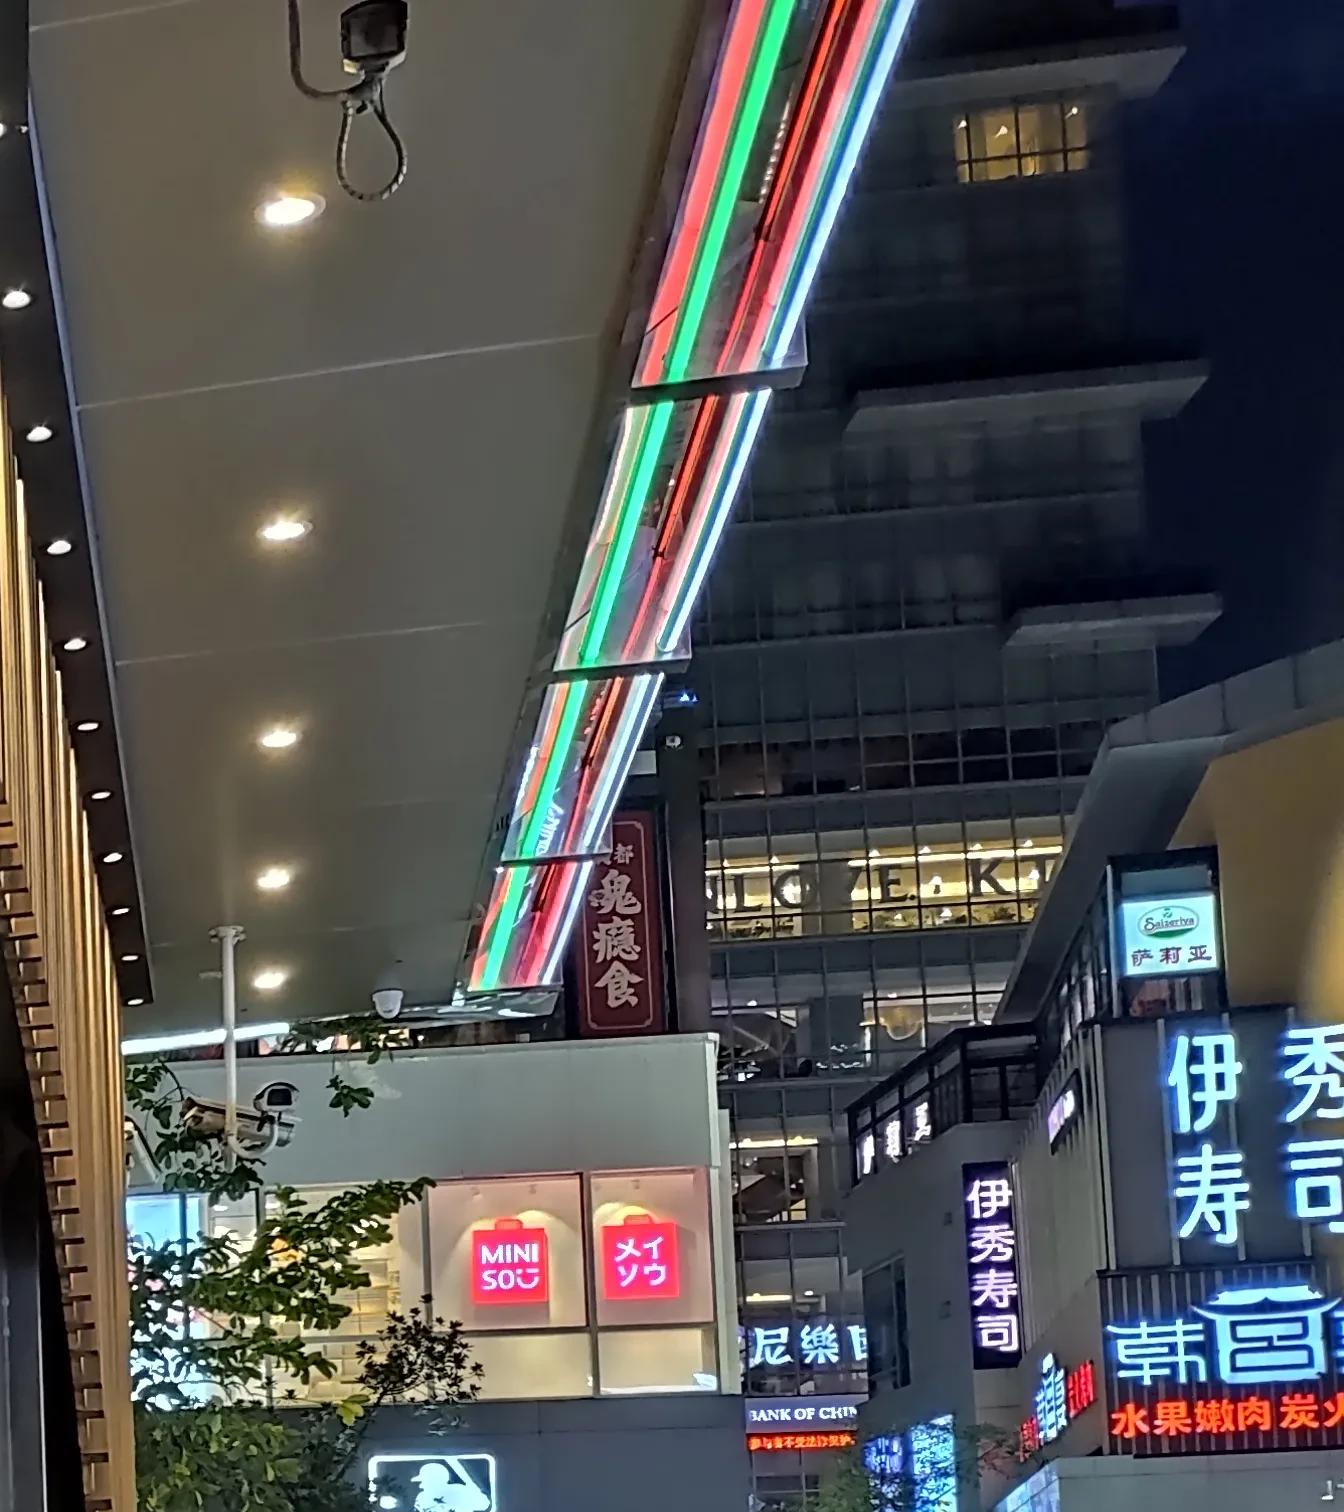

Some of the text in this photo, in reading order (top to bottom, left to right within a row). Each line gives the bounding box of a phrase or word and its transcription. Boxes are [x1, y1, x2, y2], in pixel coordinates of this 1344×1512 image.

[1132, 945, 1212, 967] 萨莉亚
[480, 1240, 540, 1263] MINI
[614, 1237, 663, 1263] メイ
[616, 1263, 667, 1288] ソウ
[967, 1178, 1019, 1352] 伊秀寿司
[750, 1409, 792, 1422] BANK
[794, 1408, 816, 1421] OF
[1112, 1398, 1272, 1440] 水果嫩肉
